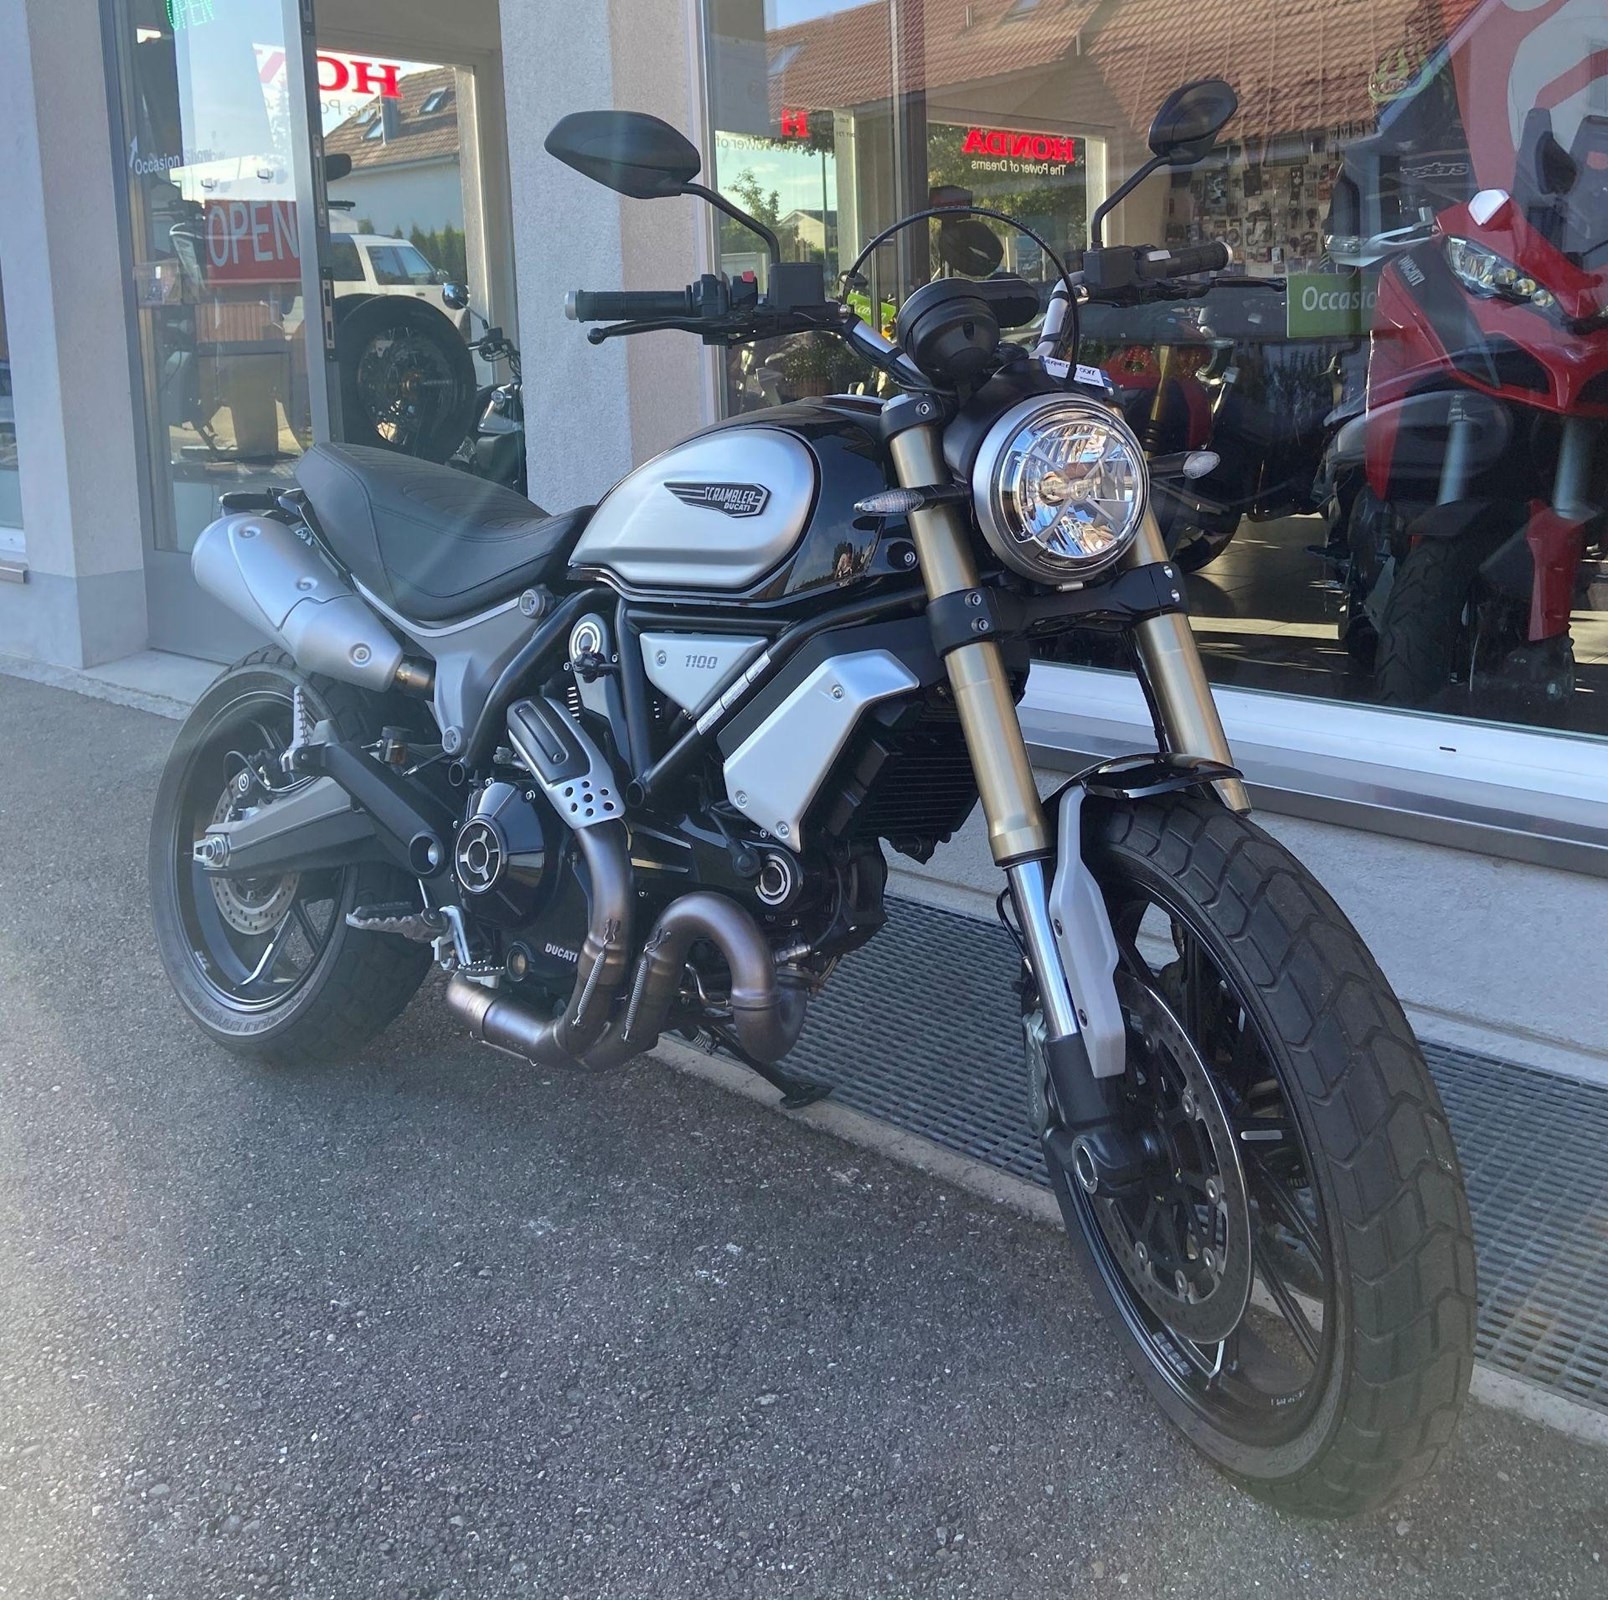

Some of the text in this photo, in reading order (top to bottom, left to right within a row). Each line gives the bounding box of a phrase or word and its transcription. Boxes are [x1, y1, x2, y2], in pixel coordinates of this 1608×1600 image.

[134, 153, 180, 174] Occasion
[208, 200, 300, 267] OPEN
[1302, 286, 1378, 311] Occasio
[704, 486, 756, 505] SCRAMBLER
[723, 503, 751, 512] DUCATI
[685, 654, 718, 669] 1100
[544, 942, 578, 963] DUCATI
